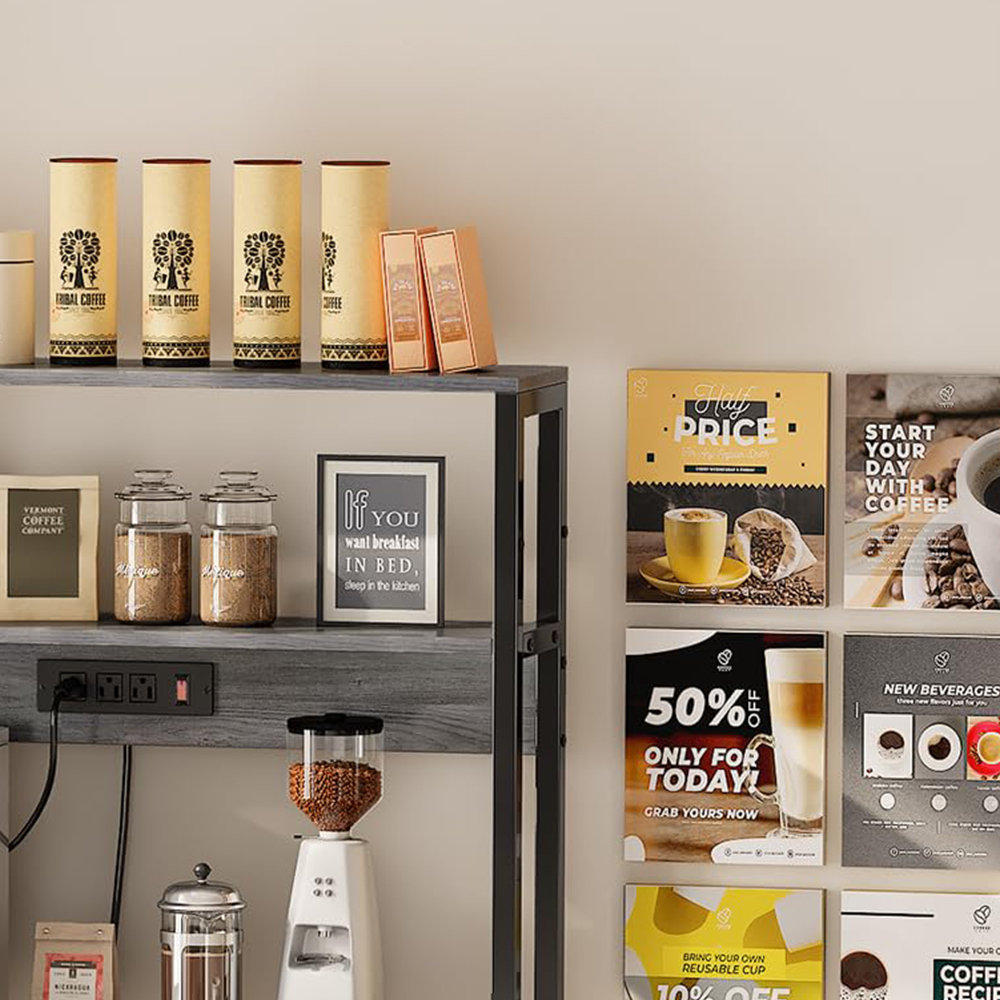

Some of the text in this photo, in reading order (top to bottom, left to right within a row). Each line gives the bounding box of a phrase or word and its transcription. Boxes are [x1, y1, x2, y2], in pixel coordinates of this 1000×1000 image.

[55, 293, 106, 306] TRIBAL COFFEE
[148, 294, 199, 307] TRIBAL COFFEE
[240, 295, 291, 308] TRIBAL COFFEE
[674, 414, 779, 446] PRICE
[865, 424, 936, 441] START
[865, 442, 926, 459] YOUR
[865, 460, 910, 477] DAY
[865, 478, 924, 494] WITH
[344, 489, 419, 530] If YOU
[865, 496, 950, 513] COFFEE
[22, 515, 64, 526] COFFEE
[345, 533, 420, 550] want breakfast
[345, 557, 419, 577] IN BED,
[344, 579, 421, 592] sleep in the kitchen
[884, 684, 1000, 697] NEW BEVERAGES
[644, 687, 761, 728] 50% OFF
[645, 747, 760, 768] ONLY FOR
[645, 767, 760, 793] TODAY!
[644, 806, 760, 820] GRAB YOURS NOW
[683, 952, 765, 963] BRING YOUR OWN
[947, 946, 970, 955] MAKE
[972, 947, 995, 956] YOUR
[682, 963, 766, 975] REUSABLE CUP
